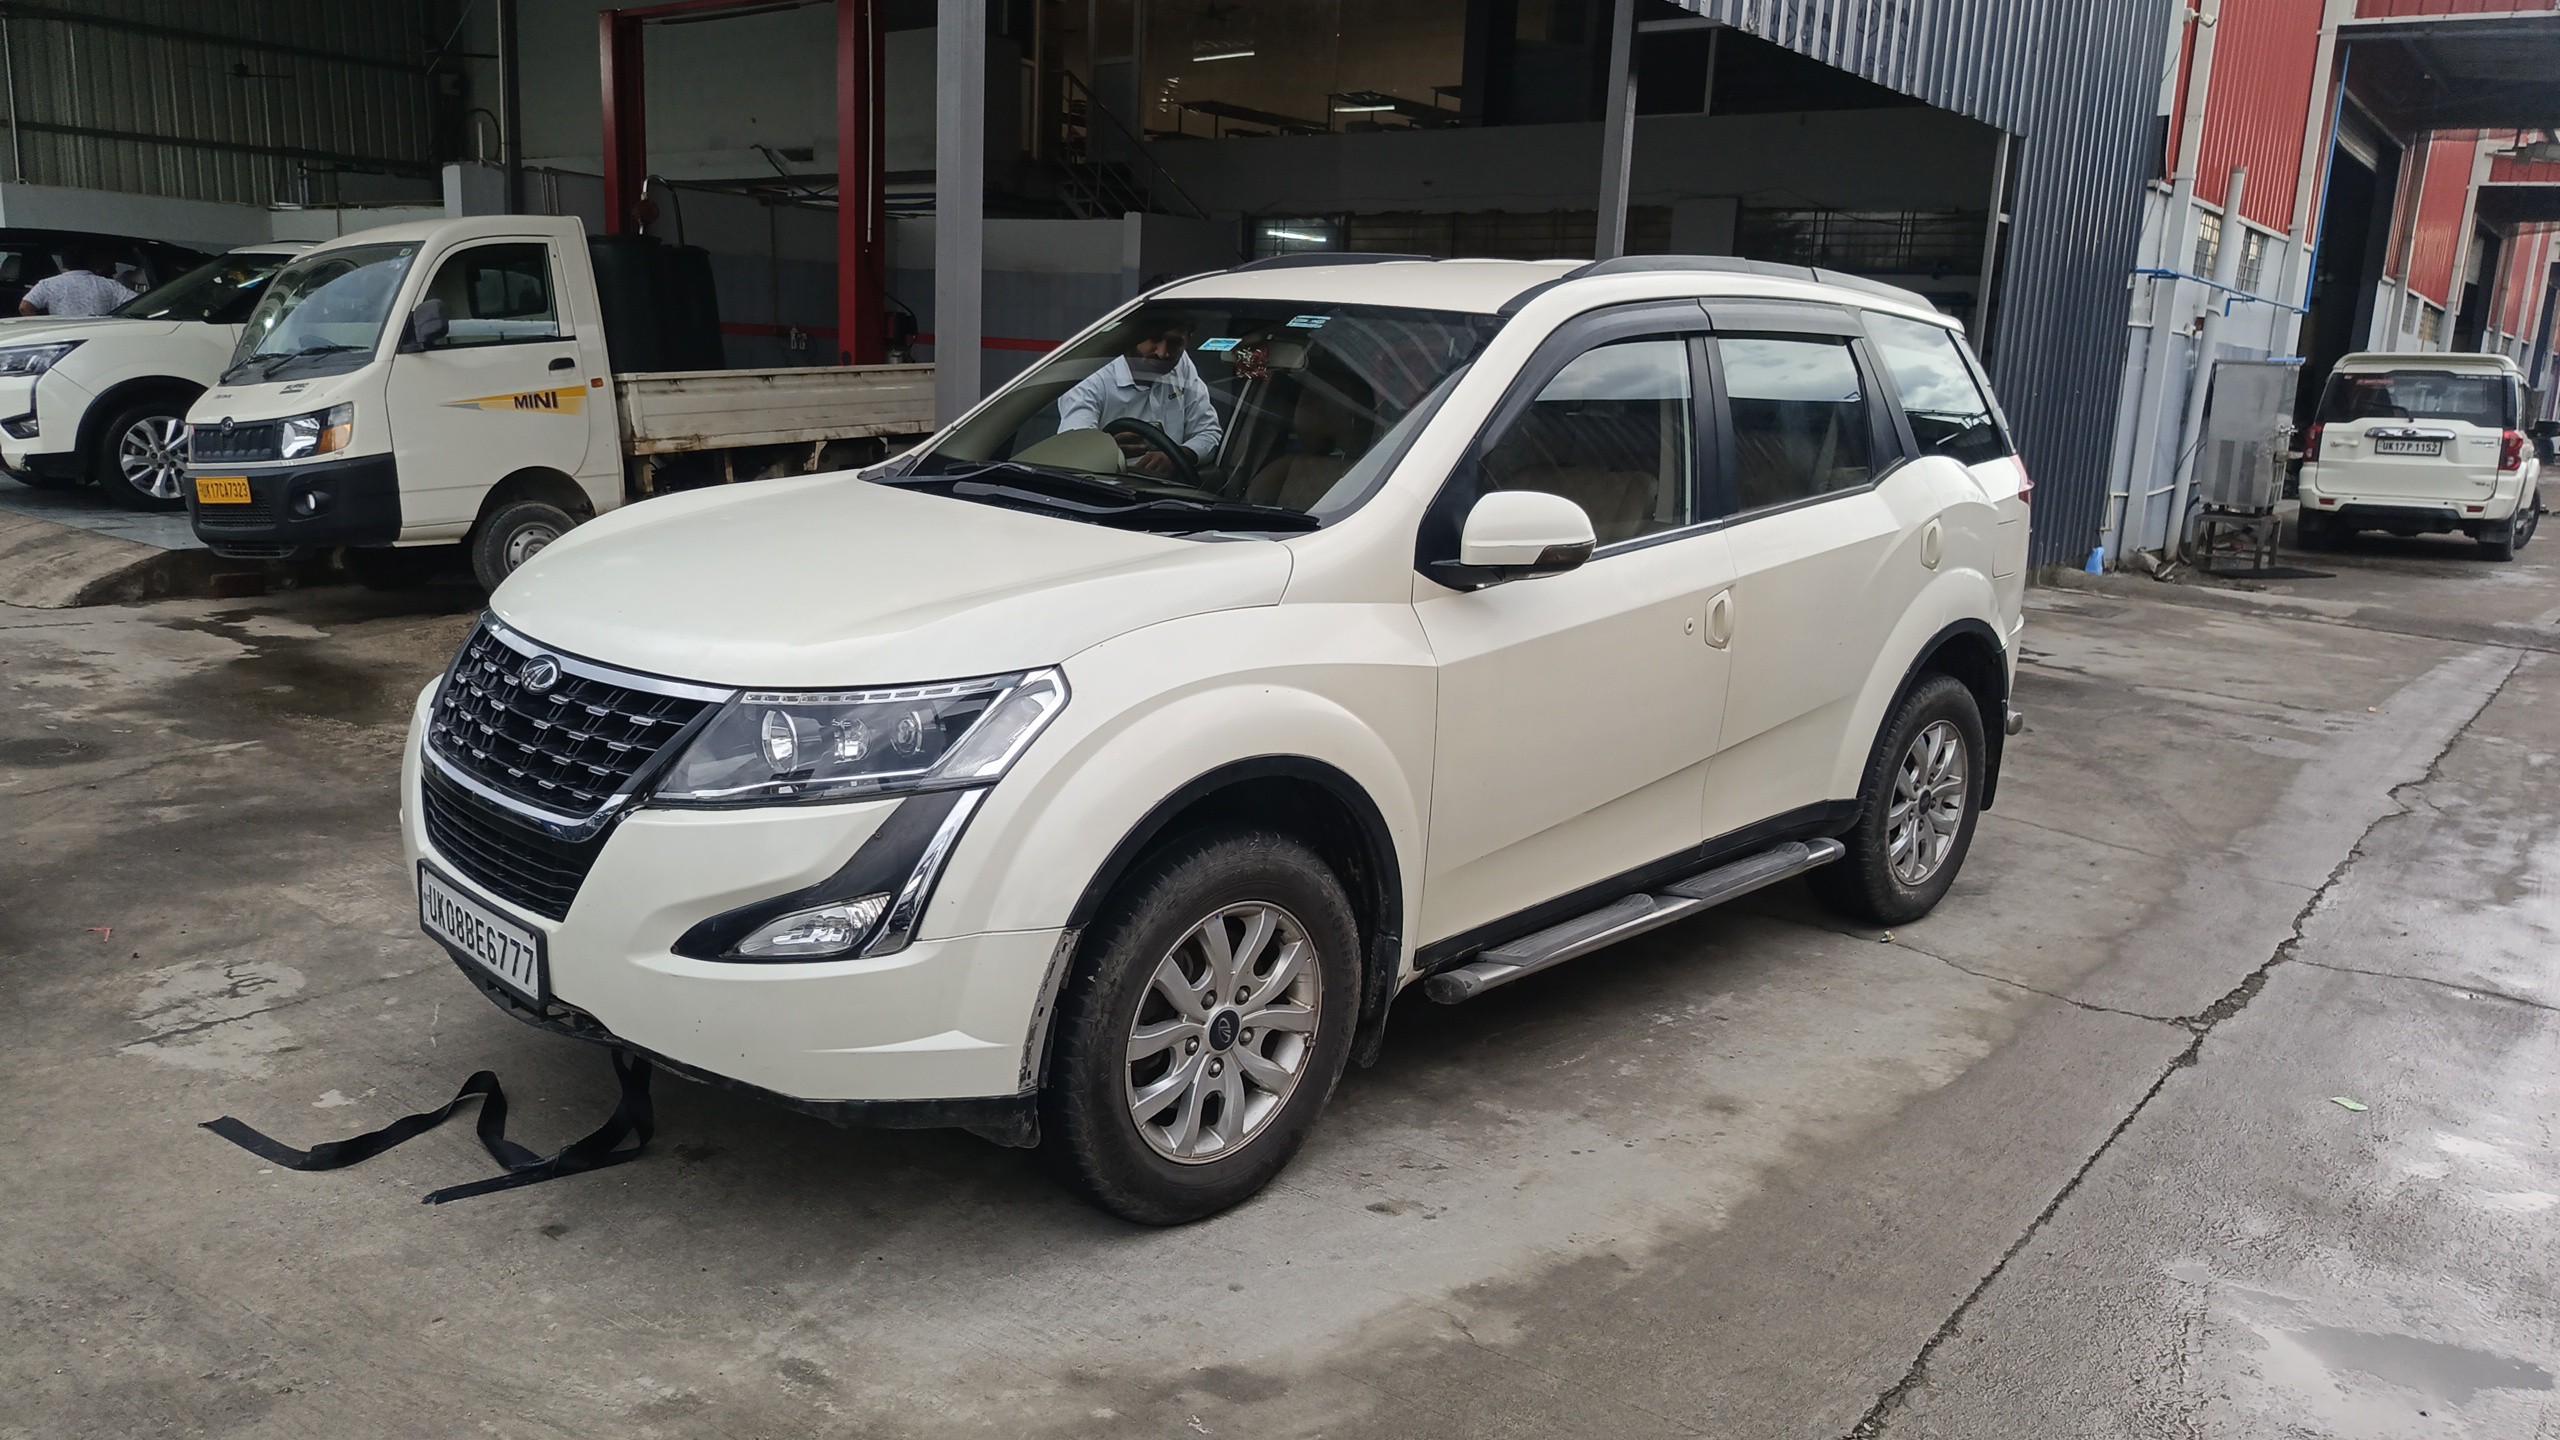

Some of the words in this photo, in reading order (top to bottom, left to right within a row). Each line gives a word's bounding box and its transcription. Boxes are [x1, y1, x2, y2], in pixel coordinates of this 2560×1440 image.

[513, 391, 559, 409] MINI
[2382, 442, 2406, 452] UK17
[202, 482, 248, 498] UK17CA7323
[428, 884, 534, 985] UK08BE6777
